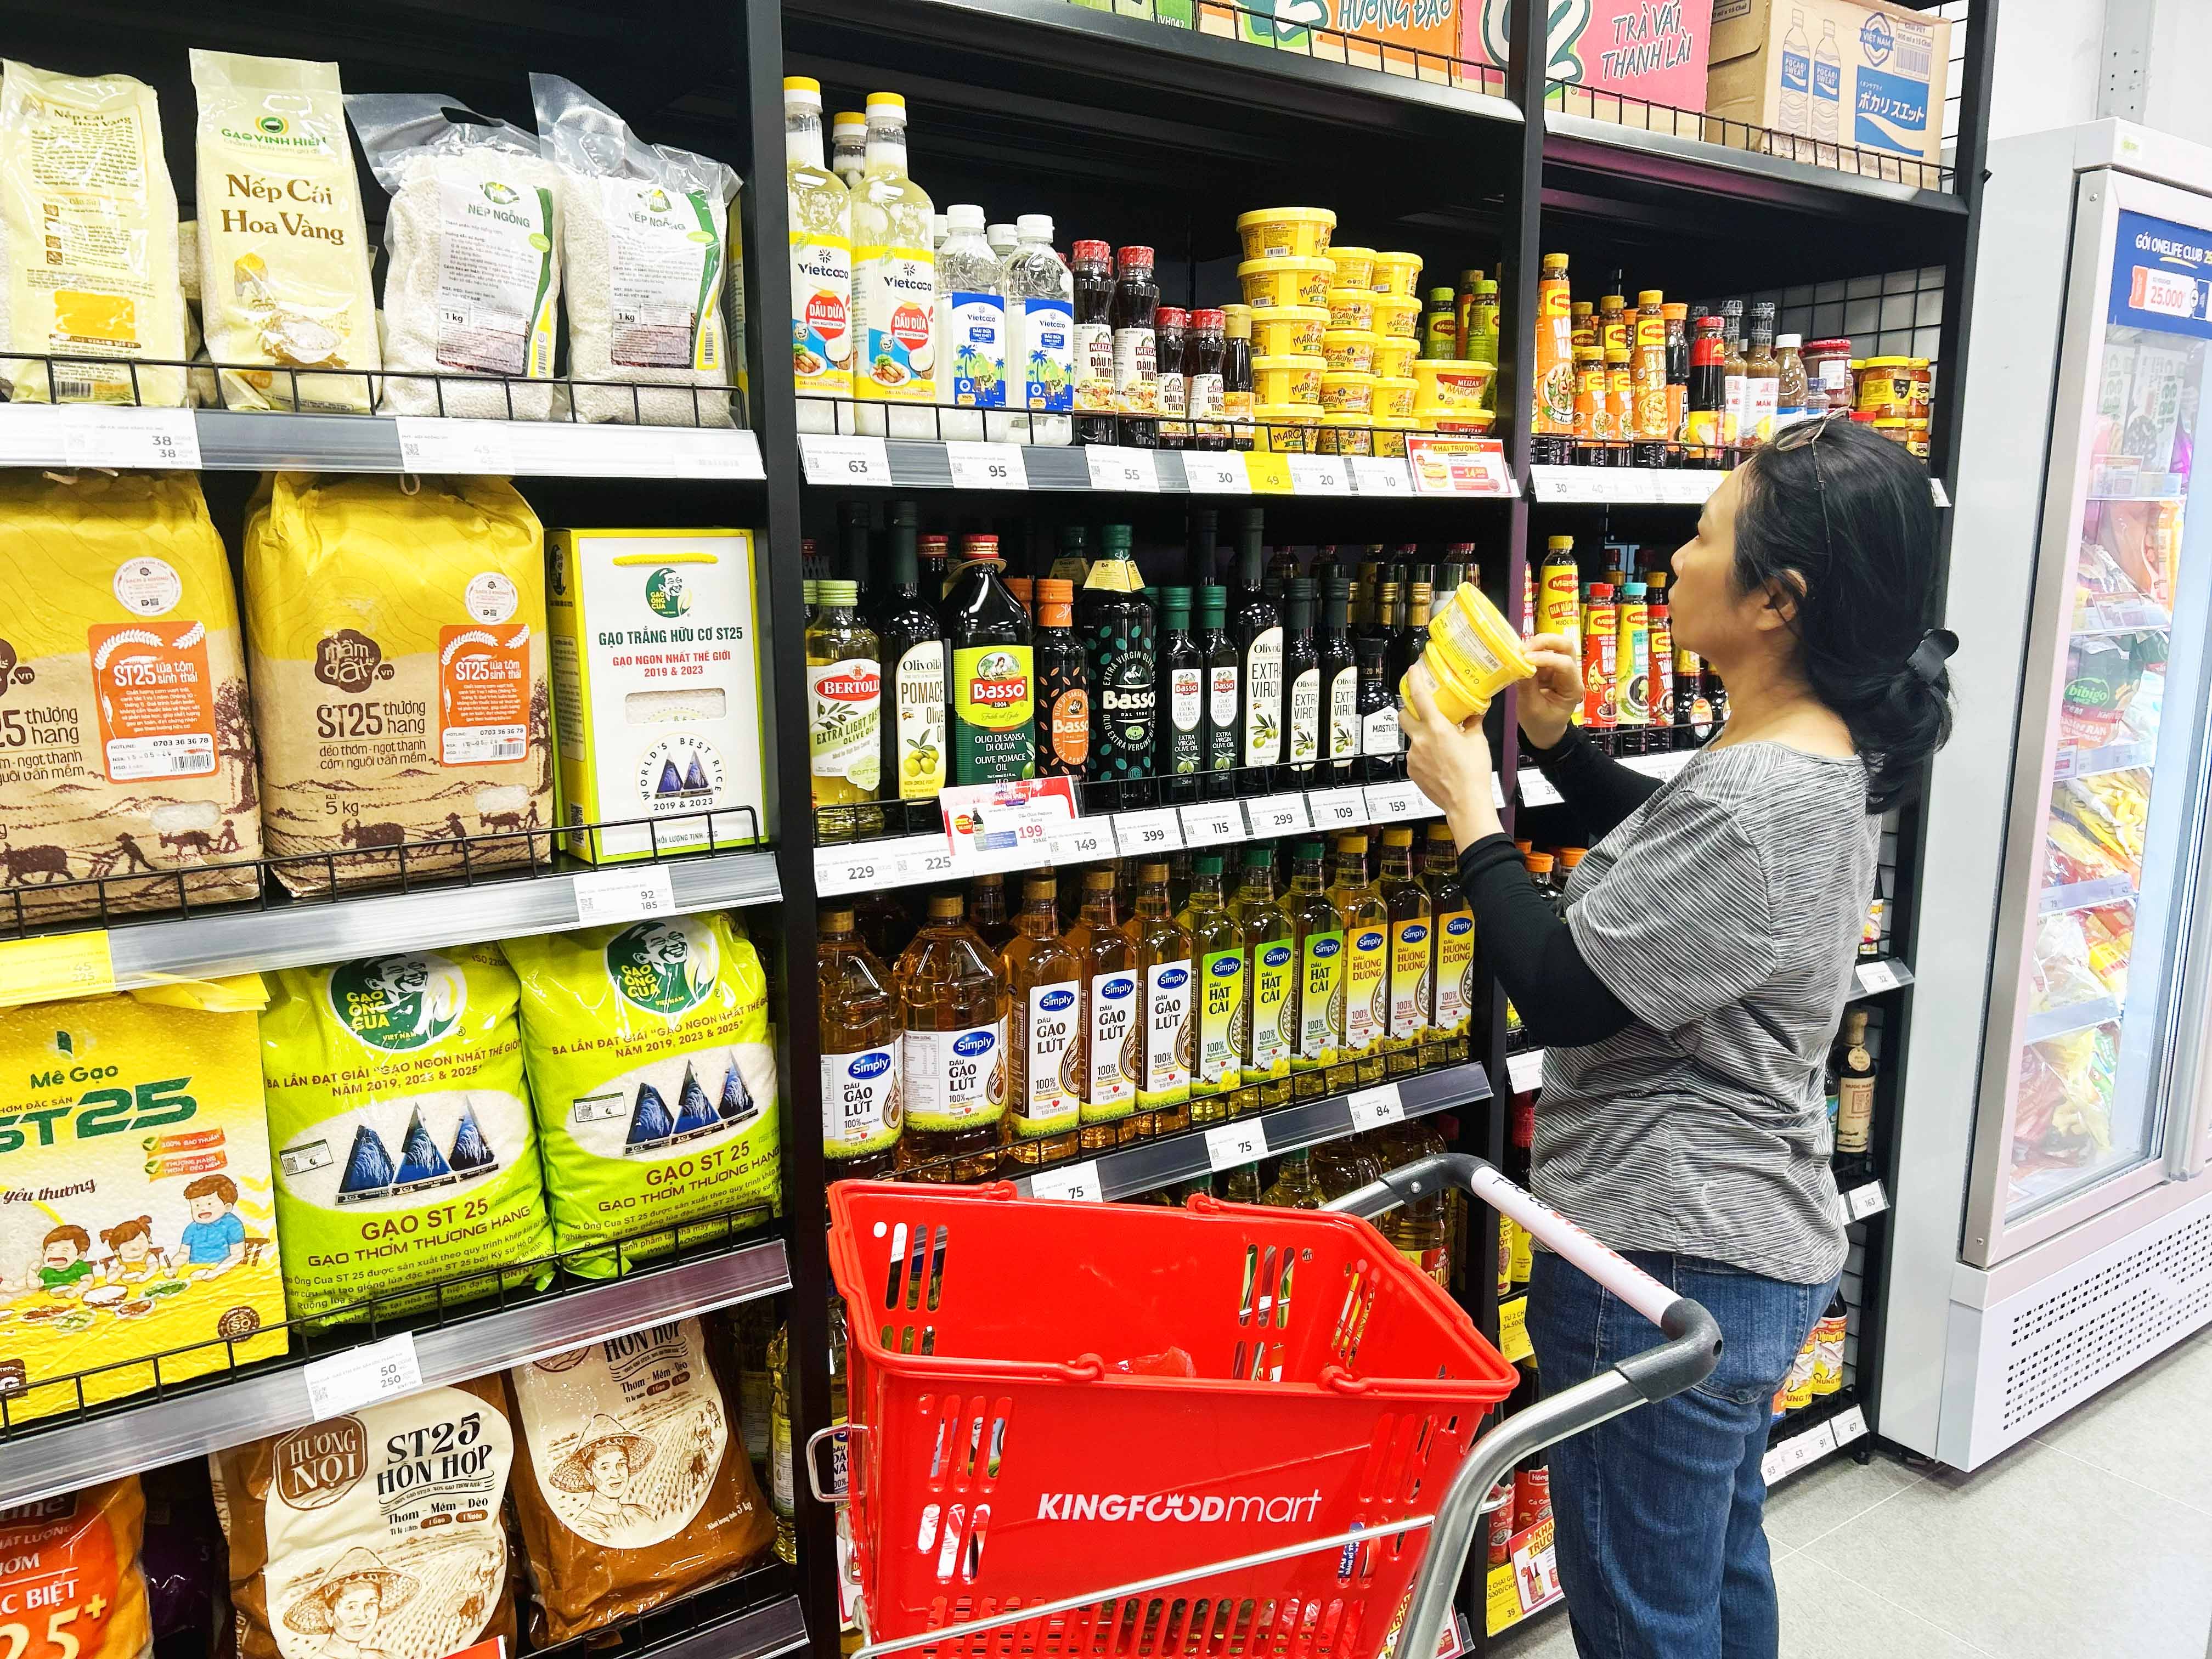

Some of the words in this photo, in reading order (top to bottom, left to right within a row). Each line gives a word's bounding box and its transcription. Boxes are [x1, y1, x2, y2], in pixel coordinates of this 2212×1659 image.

[1602, 41, 1663, 79] THANH
[1666, 29, 1692, 68] LÀI
[1785, 58, 1807, 70] POCARI
[1785, 65, 1804, 76] SWEAT
[1817, 67, 1837, 79] POCARI
[1816, 75, 1835, 86] SWEAT
[226, 174, 283, 203] Nếp
[221, 210, 279, 235] Hoa
[279, 212, 345, 246] Vàng
[2136, 232, 2151, 250] GÓI
[2152, 238, 2183, 257] ONELIFE
[2183, 245, 2203, 262] CLUB
[798, 262, 849, 279] Vietcoco
[884, 275, 932, 291] Vietcoco
[625, 313, 635, 323] kg
[967, 313, 996, 323] Vietcoco
[1458, 379, 1480, 387] MEIZAN
[152, 435, 172, 445] 38
[159, 448, 176, 458] 38
[848, 460, 868, 473] 63
[989, 465, 1007, 477] 95
[1125, 469, 1140, 481] 55
[1217, 472, 1233, 484] 30
[1267, 475, 1279, 485] 49
[1319, 475, 1334, 486] 20
[1384, 476, 1396, 487] 10
[1555, 483, 1567, 493] 30
[599, 631, 624, 648] GẠO
[627, 625, 667, 645] TRẮNG
[670, 626, 695, 643] HỮU
[697, 627, 714, 641] CƠ
[716, 627, 743, 640] ST25
[612, 656, 633, 668] GẠO
[635, 654, 663, 665] NGON
[665, 650, 691, 664] NHẤT
[693, 648, 710, 662] THẾ
[712, 648, 731, 662] GIỚI
[114, 663, 156, 686] ST25
[644, 667, 668, 678] 2019
[670, 667, 678, 676] &
[681, 665, 704, 675] 2023
[901, 681, 943, 704] POMACE
[973, 680, 1025, 700] Basso
[1175, 684, 1198, 693] Basso
[1102, 690, 1156, 710] Basso
[383, 700, 426, 717] thượng
[926, 706, 945, 724] Olive
[24, 707, 79, 725] thượng
[316, 702, 383, 738] ST25
[387, 718, 425, 736] hạng
[936, 725, 945, 743] Oil
[32, 726, 80, 747] hạng
[974, 735, 994, 743] OLIO
[994, 735, 1003, 743] DI
[1003, 732, 1026, 742] SANSA
[985, 743, 994, 752] DI
[995, 741, 1016, 751] OLIVA
[975, 755, 996, 765] OLIVE
[997, 753, 1026, 763] POMACE
[52, 763, 85, 778] mềm
[996, 763, 1008, 772] OIL
[325, 800, 338, 815] 5
[343, 801, 359, 817] kg
[653, 801, 676, 811] 2019
[679, 800, 686, 809] &
[689, 797, 714, 808] 2023
[1389, 800, 1406, 812] 159
[1273, 813, 1294, 826] 299
[1334, 806, 1353, 819] 109
[1019, 826, 1043, 839] 199
[1211, 822, 1230, 834] 115
[1142, 829, 1165, 842] 399
[1074, 838, 1097, 852] 149
[925, 856, 952, 871] 225
[848, 865, 875, 881] 229
[640, 890, 656, 900] 92
[641, 902, 658, 910] 185
[1403, 928, 1427, 939] Simply
[1448, 921, 1471, 932] Simply
[1358, 936, 1383, 948] Simply
[1443, 941, 1471, 955] HƯỚNG
[1397, 950, 1426, 963] HƯỚNG
[1442, 951, 1471, 964] DƯƠNG
[1352, 957, 1382, 971] HƯỚNG
[1397, 960, 1426, 973] DƯƠNG
[1310, 966, 1331, 981] HẠT
[1352, 969, 1381, 981] DƯƠNG
[1261, 975, 1283, 991] HẠT
[1310, 979, 1329, 995] CẢI
[1209, 986, 1232, 1002] HẠT
[1261, 988, 1280, 1004] CẢI
[1441, 991, 1458, 1002] 100%
[1155, 998, 1181, 1015] GẠO
[1208, 998, 1229, 1015] CẢI
[1396, 1000, 1413, 1011] 100%
[1099, 1009, 1126, 1026] GẠO
[1351, 1008, 1368, 1020] 100%
[351, 1018, 391, 1032] CUA
[1155, 1013, 1181, 1030] LỨT
[552, 1045, 567, 1056] BA
[571, 1038, 594, 1053] LẦN
[597, 1036, 619, 1049] ĐẠT
[685, 1014, 718, 1031] NGON
[719, 1004, 745, 1024] NHẤT
[1099, 1024, 1126, 1042] LỨT
[1037, 1036, 1065, 1055] LỨT
[31, 1070, 65, 1089] Mê
[70, 1065, 119, 1085] Gạo
[843, 1086, 873, 1103] GẠO
[1375, 1104, 1390, 1118] 84
[1238, 1141, 1252, 1153] 75
[646, 1160, 695, 1186] GẠO
[700, 1149, 725, 1172] ST
[730, 1140, 751, 1160] 25
[3, 1188, 33, 1204] yêu
[38, 1178, 97, 1201] thương
[598, 1197, 636, 1212] GẠO
[640, 1184, 685, 1204] THƠM
[689, 1163, 749, 1191] THƯỢNG
[1068, 1186, 1084, 1200] 75
[1864, 1198, 1876, 1207] 163
[360, 1214, 419, 1242] GẠO
[427, 1206, 456, 1229] ST
[464, 1197, 489, 1220] 25
[308, 1251, 350, 1269] GẠO
[354, 1240, 409, 1262] THƠM
[414, 1223, 488, 1249] THƯỢNG
[492, 1205, 532, 1232] HẠNG
[380, 1363, 397, 1377] 50
[380, 1374, 402, 1389] 250
[386, 1412, 481, 1466] ST25
[289, 1427, 357, 1466] HƯƠNG
[1795, 1449, 1804, 1459] 53
[736, 1504, 743, 1514] 5
[744, 1502, 753, 1511] kg
[1036, 1488, 1323, 1523] KINGFOODmart
[26, 1578, 80, 1610] BIỆT
[1506, 1608, 1516, 1617] 39
